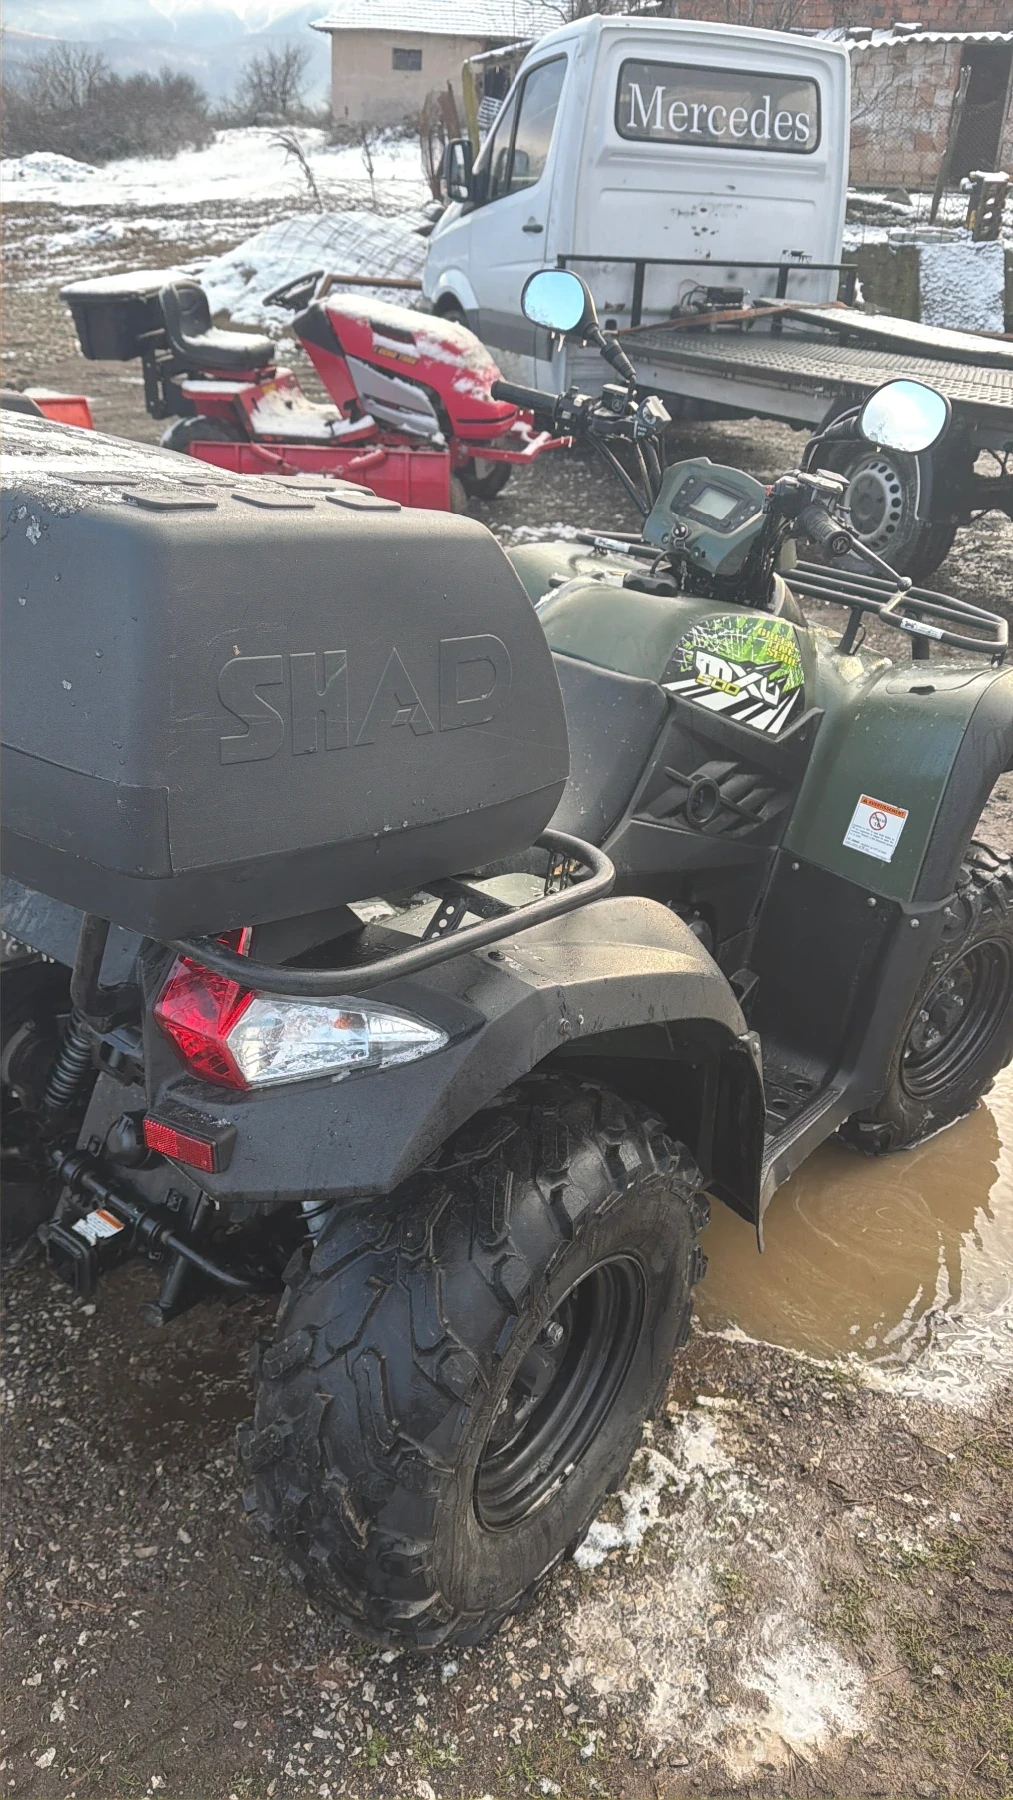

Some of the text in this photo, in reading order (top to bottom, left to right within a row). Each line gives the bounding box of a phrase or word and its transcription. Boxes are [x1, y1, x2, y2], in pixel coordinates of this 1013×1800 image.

[627, 83, 810, 142] Mercedes
[757, 627, 796, 650] GREEN
[769, 639, 796, 658] LINE
[695, 674, 740, 697] 500
[218, 634, 512, 765] SHAD
[868, 801, 905, 816] AVERTISSEMENT
